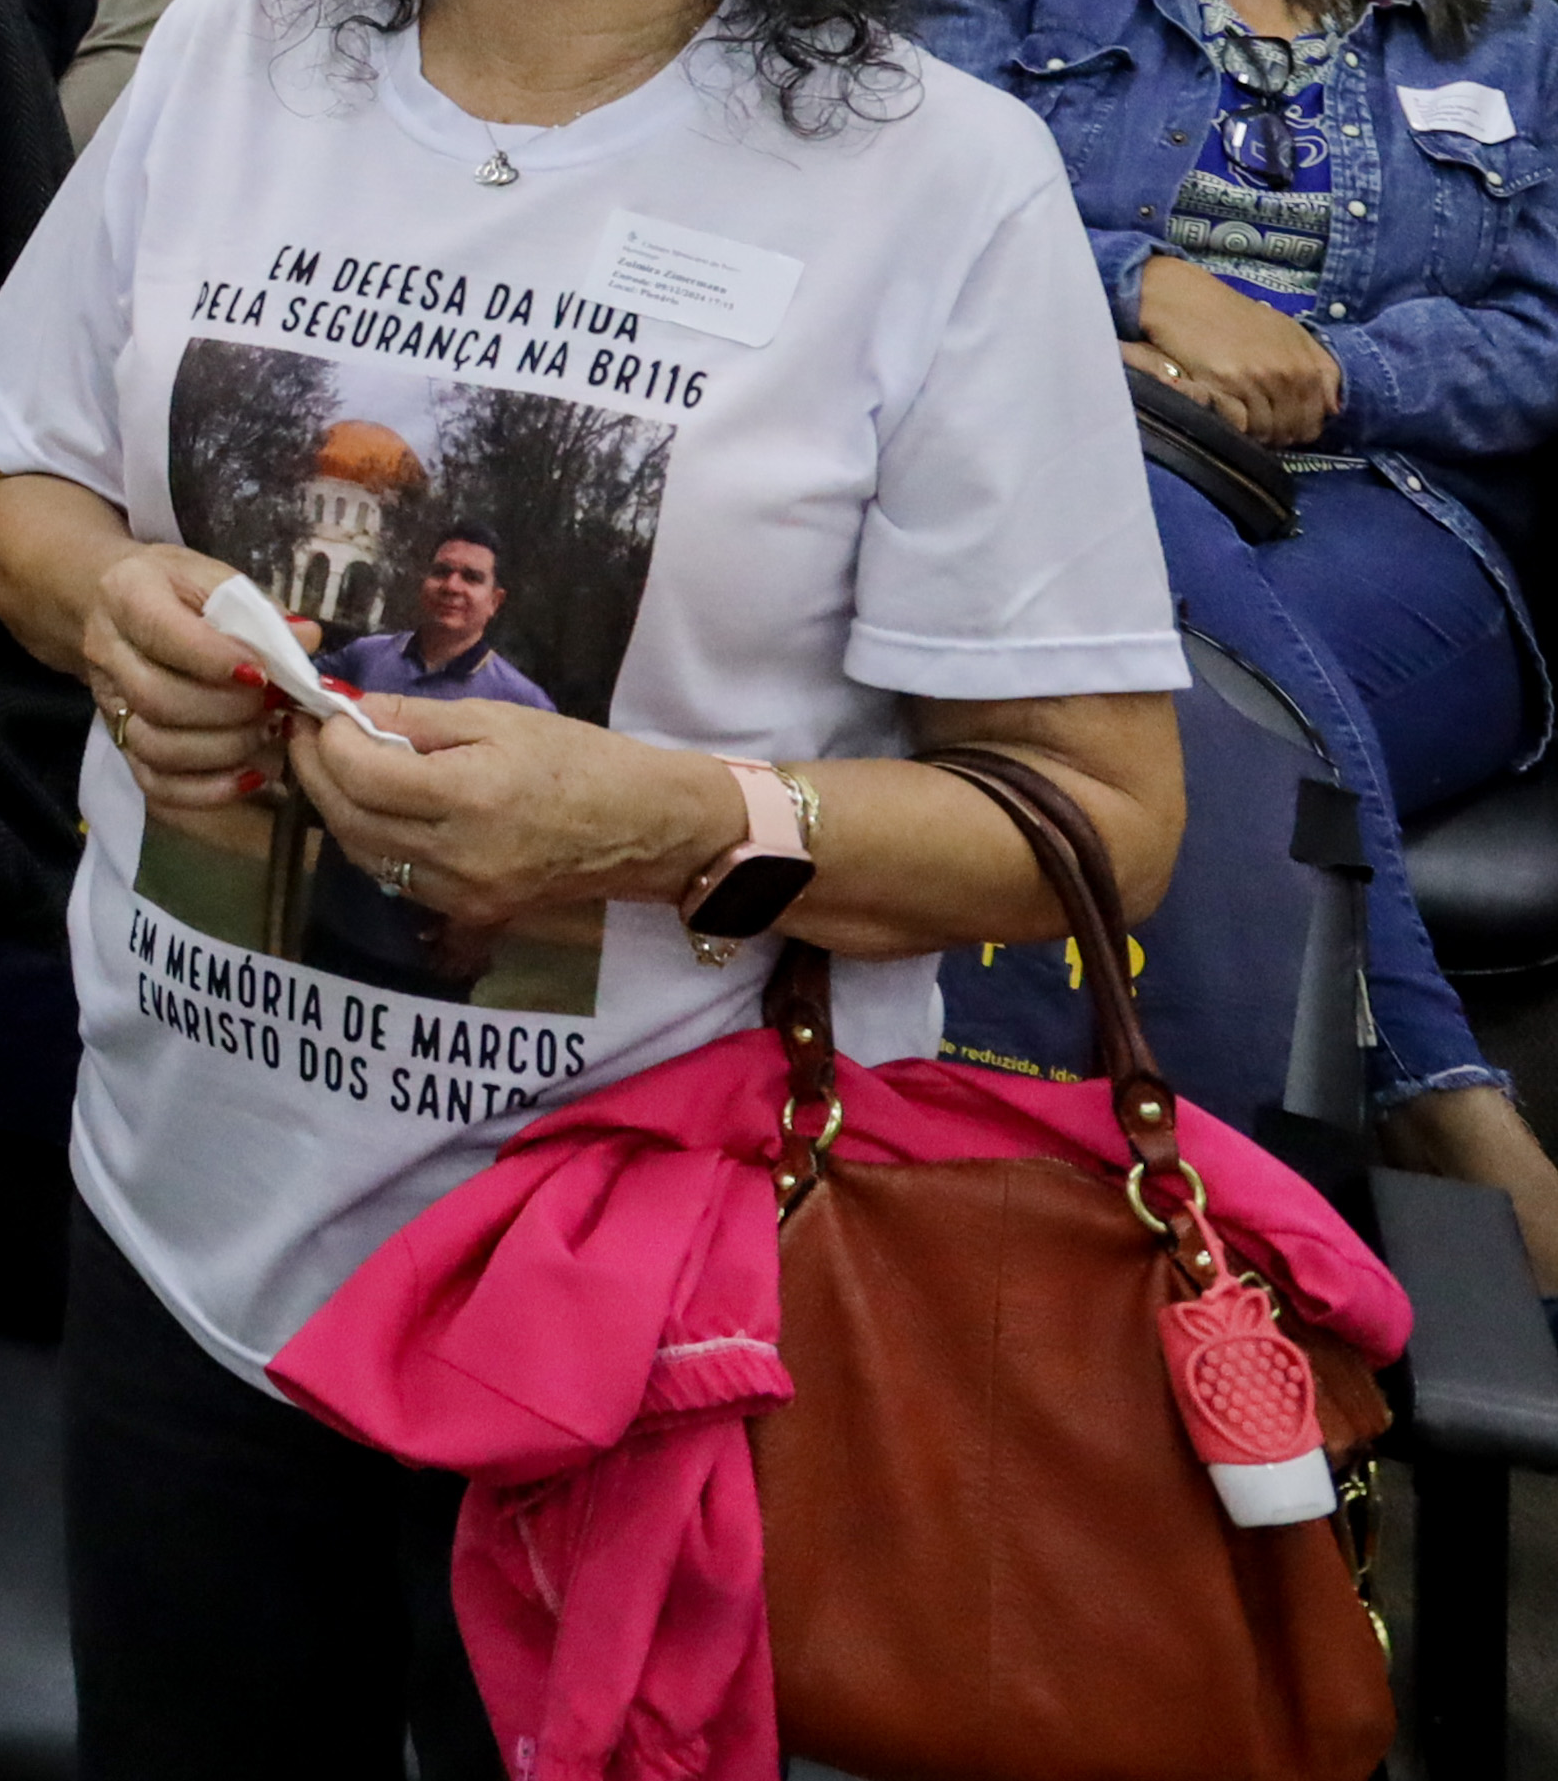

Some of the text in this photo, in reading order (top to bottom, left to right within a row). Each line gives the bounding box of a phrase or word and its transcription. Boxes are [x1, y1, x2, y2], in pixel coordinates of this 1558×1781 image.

[191, 281, 709, 409] PELA SEGURANÇA NA BR116
[268, 245, 639, 344] EM DEFESA DA VIDA
[128, 908, 586, 1078] EM MEMÓRIA DE MARCOS
[138, 971, 281, 1070] EVARISTO
[298, 1035, 369, 1102] DOS
